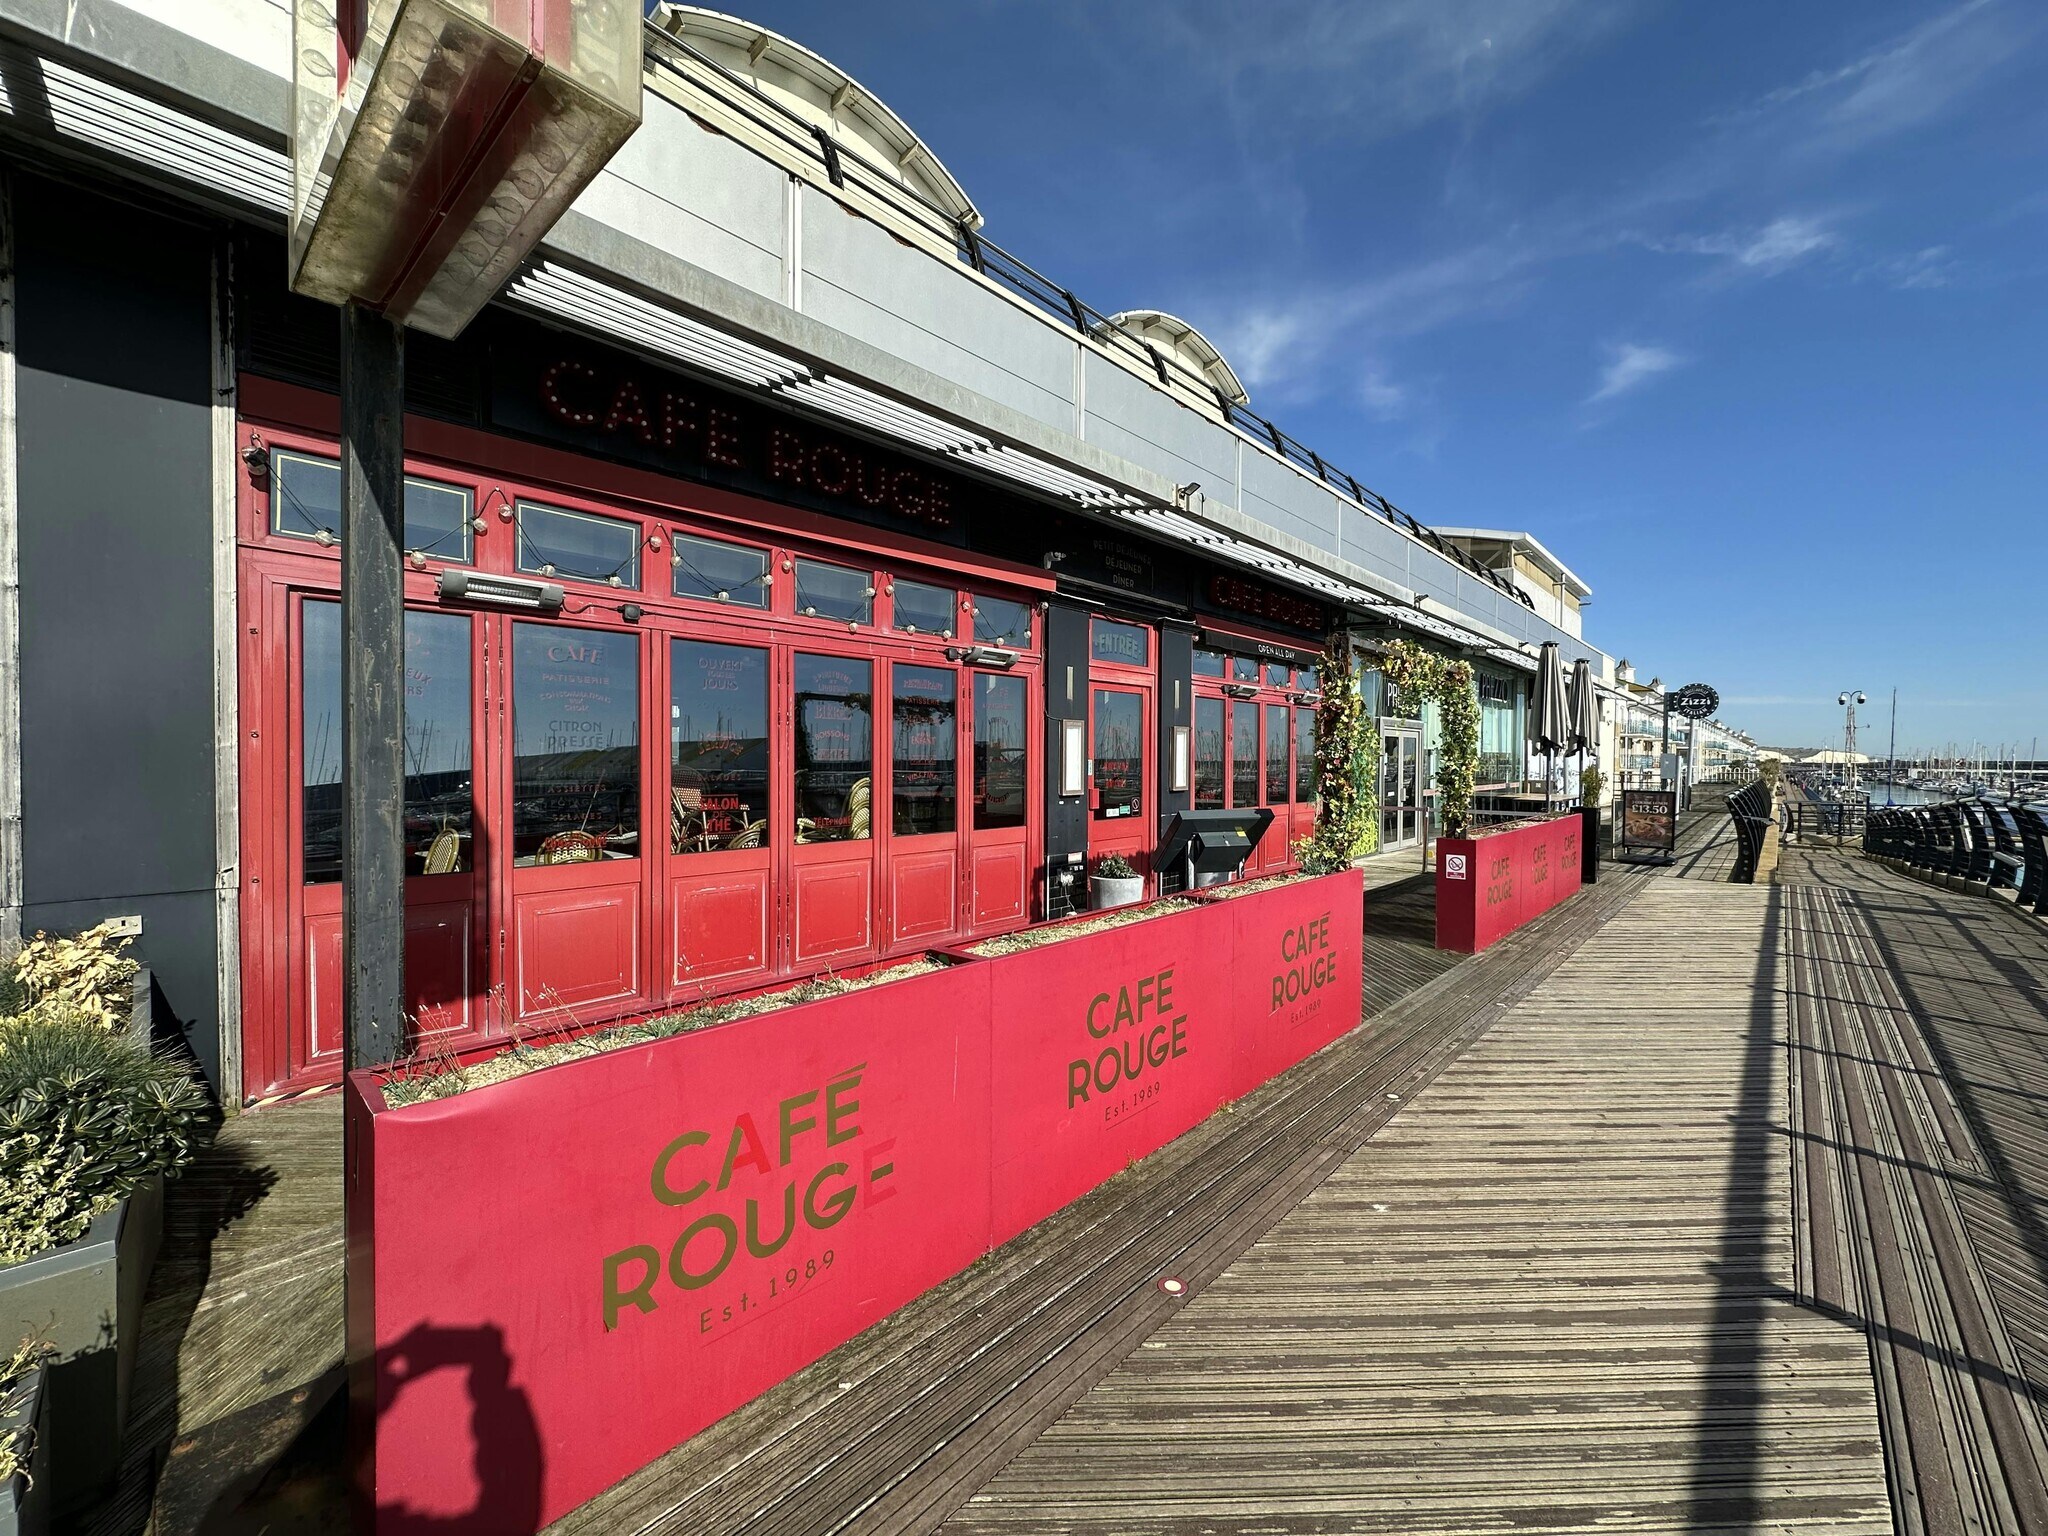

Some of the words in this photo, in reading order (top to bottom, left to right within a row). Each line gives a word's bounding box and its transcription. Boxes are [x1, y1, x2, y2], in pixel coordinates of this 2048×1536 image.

[770, 427, 953, 529] ROUGE
[1093, 539, 1114, 552] PETIT
[1257, 644, 1274, 656] OPEN
[1275, 645, 1285, 657] ALL
[1285, 648, 1296, 659] DAY
[702, 679, 739, 690] JOURS
[1683, 707, 1708, 716] ITALIAN
[549, 720, 603, 733] CITRON
[700, 797, 739, 810] SALON
[1631, 803, 1669, 815] £13.50
[1487, 878, 1513, 908] ROUGE
[1271, 951, 1337, 1013] ROUGE
[1305, 999, 1321, 1017] 1989
[1068, 1013, 1188, 1110] ROUGE
[1105, 1102, 1128, 1122] Est.
[1133, 1081, 1161, 1107] 1989
[650, 1061, 868, 1207] CAFÉ
[602, 1136, 899, 1334] ROUGE
[700, 1292, 758, 1335] Est.
[768, 1249, 836, 1299] 1989
